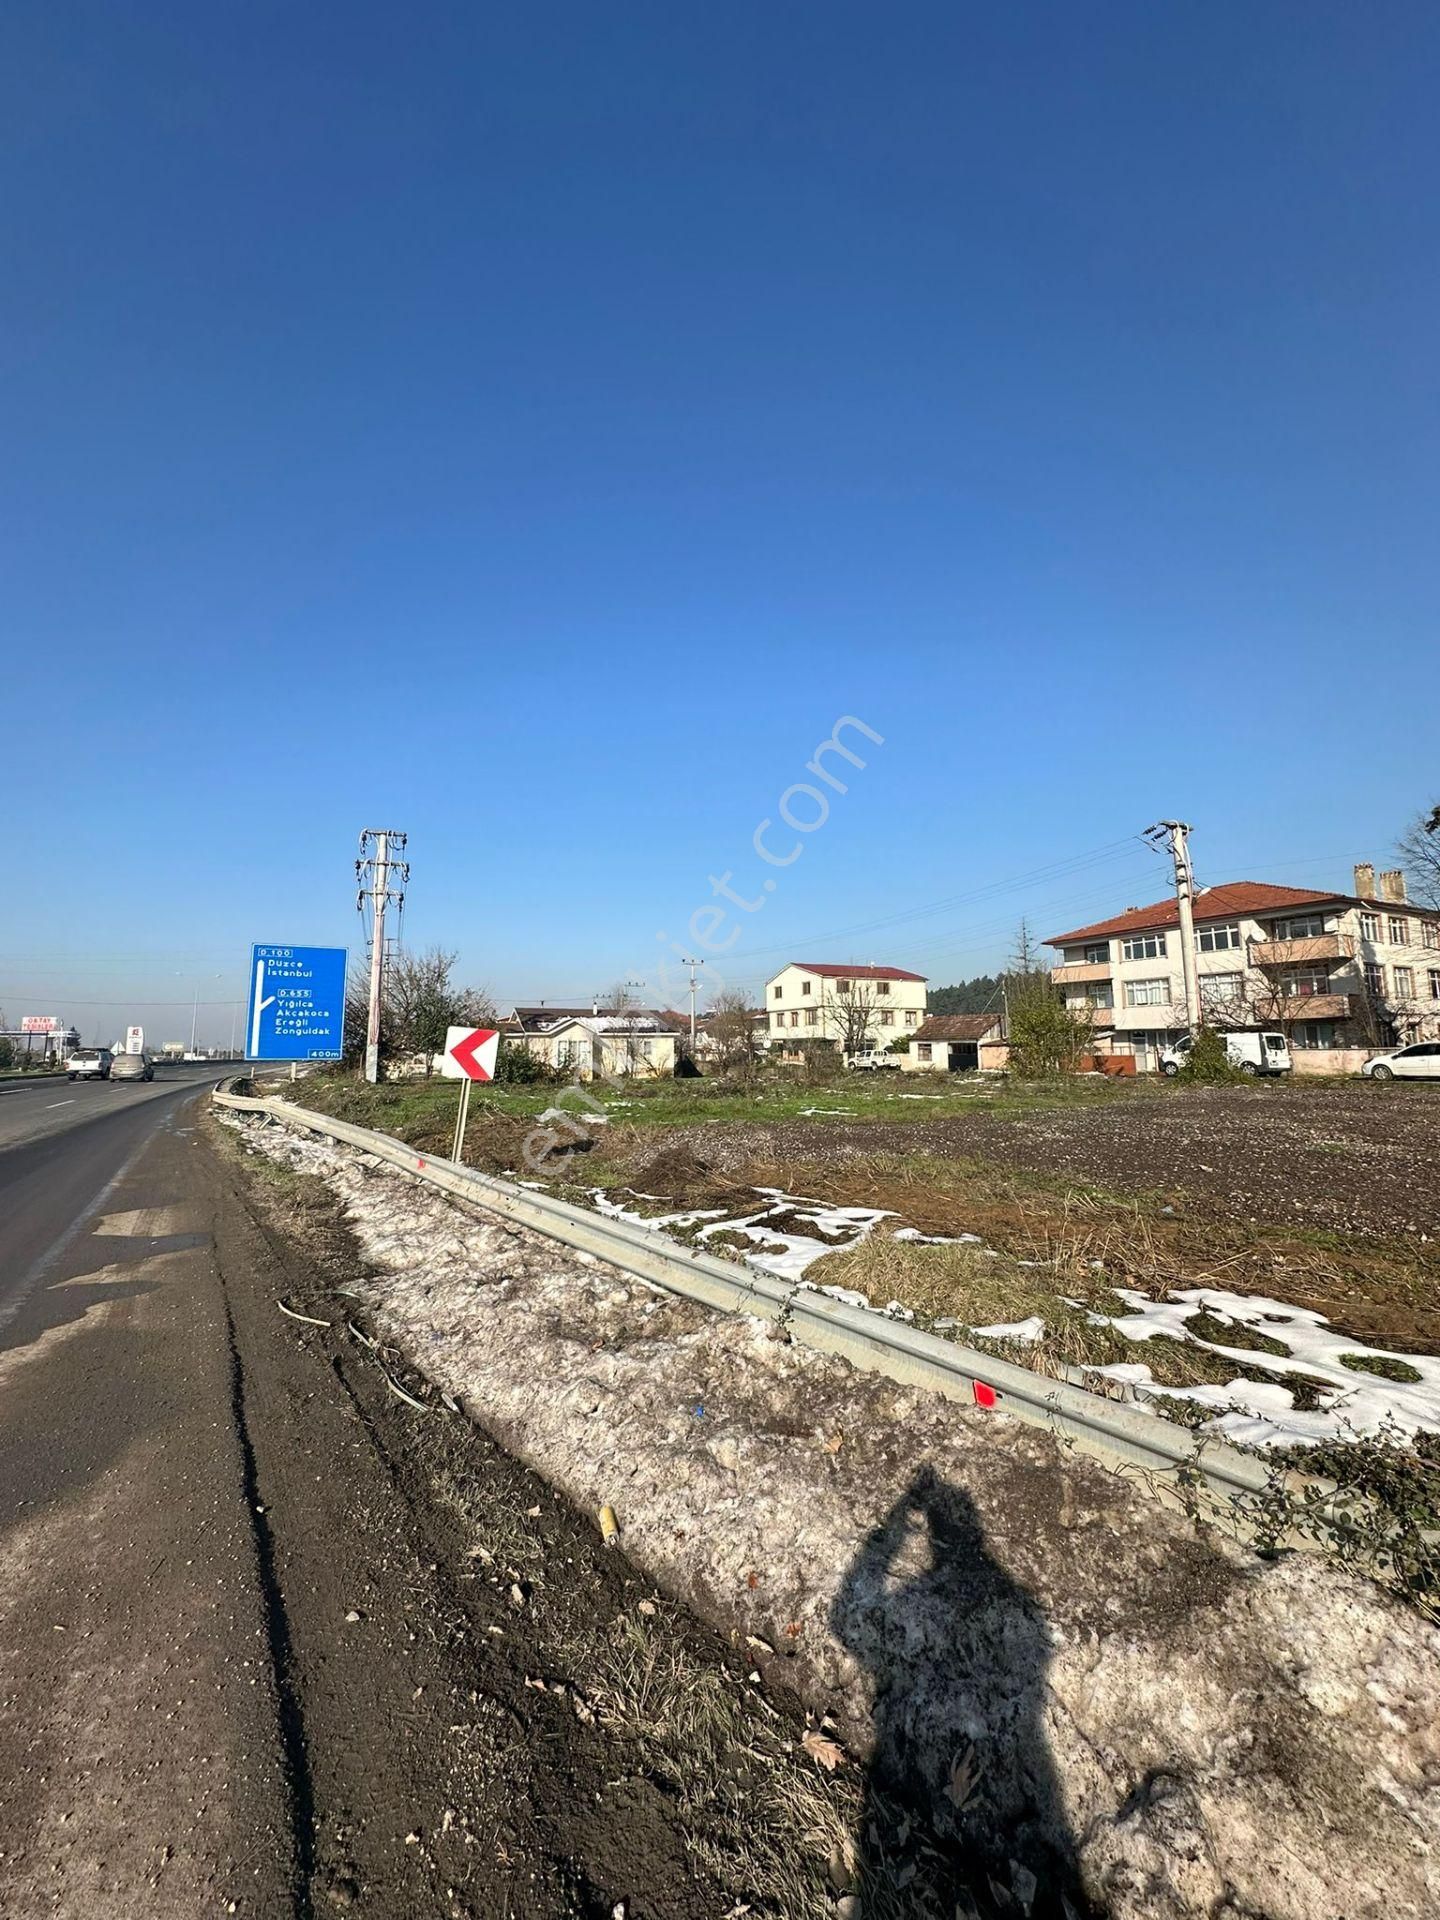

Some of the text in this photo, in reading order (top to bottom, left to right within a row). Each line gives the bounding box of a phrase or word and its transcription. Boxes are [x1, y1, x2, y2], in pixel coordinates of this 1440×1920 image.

[268, 959, 303, 968] Düzce
[267, 967, 313, 977] İstanbul
[277, 999, 314, 1009] Yığılca
[276, 1009, 330, 1017] Akçakoca
[275, 1018, 309, 1027] Ereğli
[275, 1027, 330, 1036] Zonguldak
[311, 1050, 339, 1058] 400m
